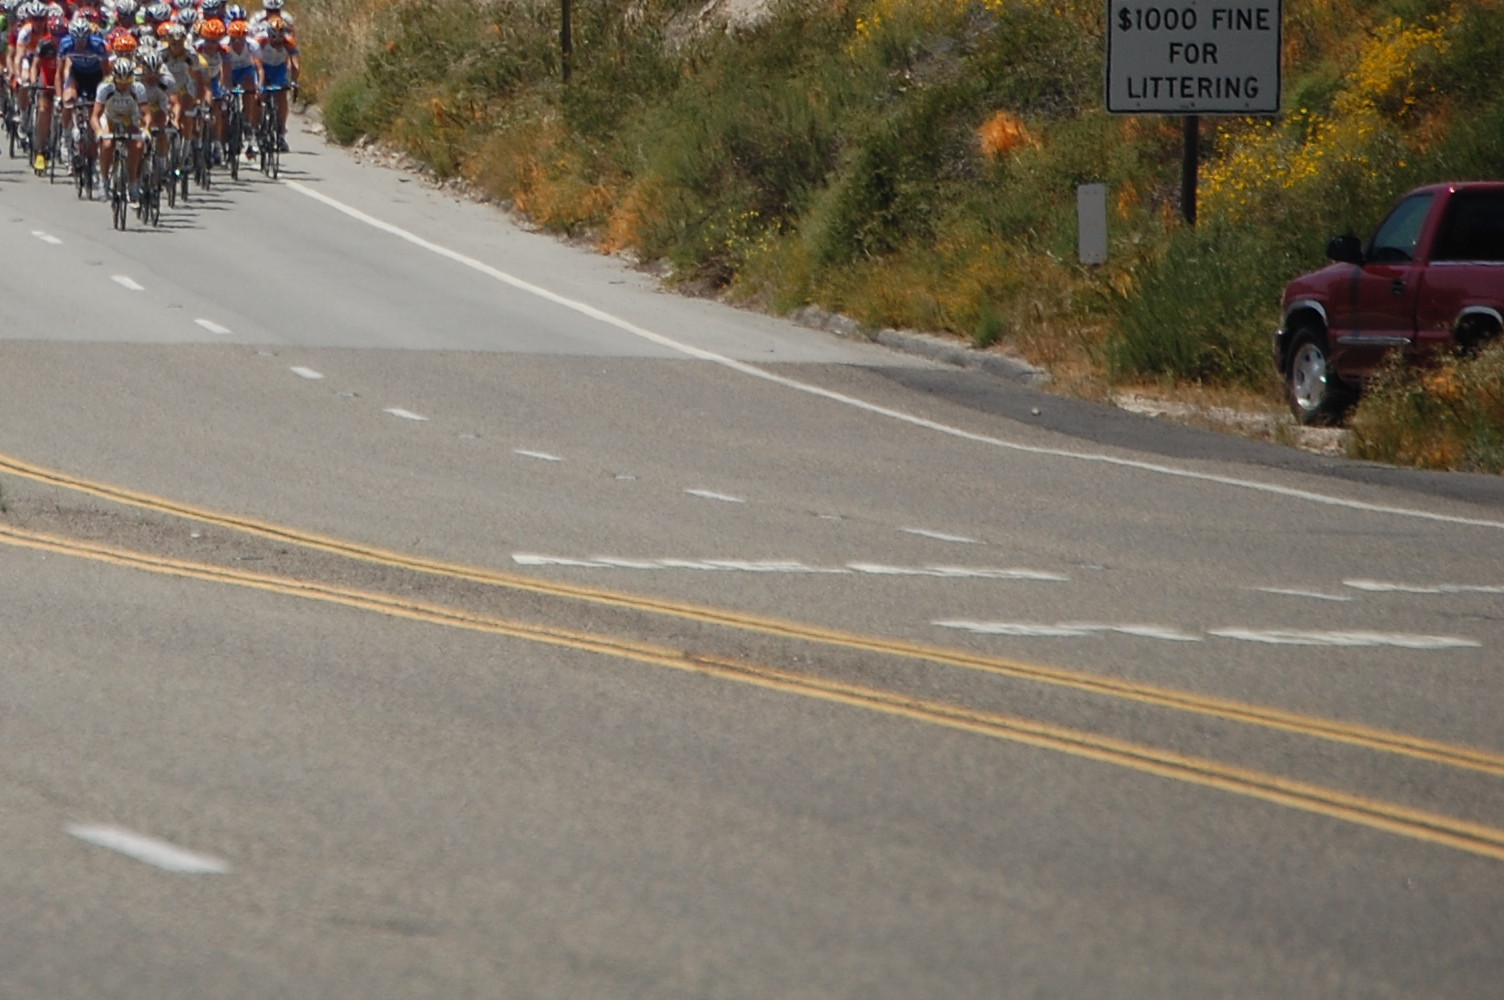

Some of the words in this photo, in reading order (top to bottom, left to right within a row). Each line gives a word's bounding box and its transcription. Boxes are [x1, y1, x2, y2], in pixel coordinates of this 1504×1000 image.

[1118, 7, 1197, 32] $1000
[1212, 8, 1271, 31] FINE
[1169, 42, 1218, 65] FOR
[1127, 76, 1259, 99] LITTERING
